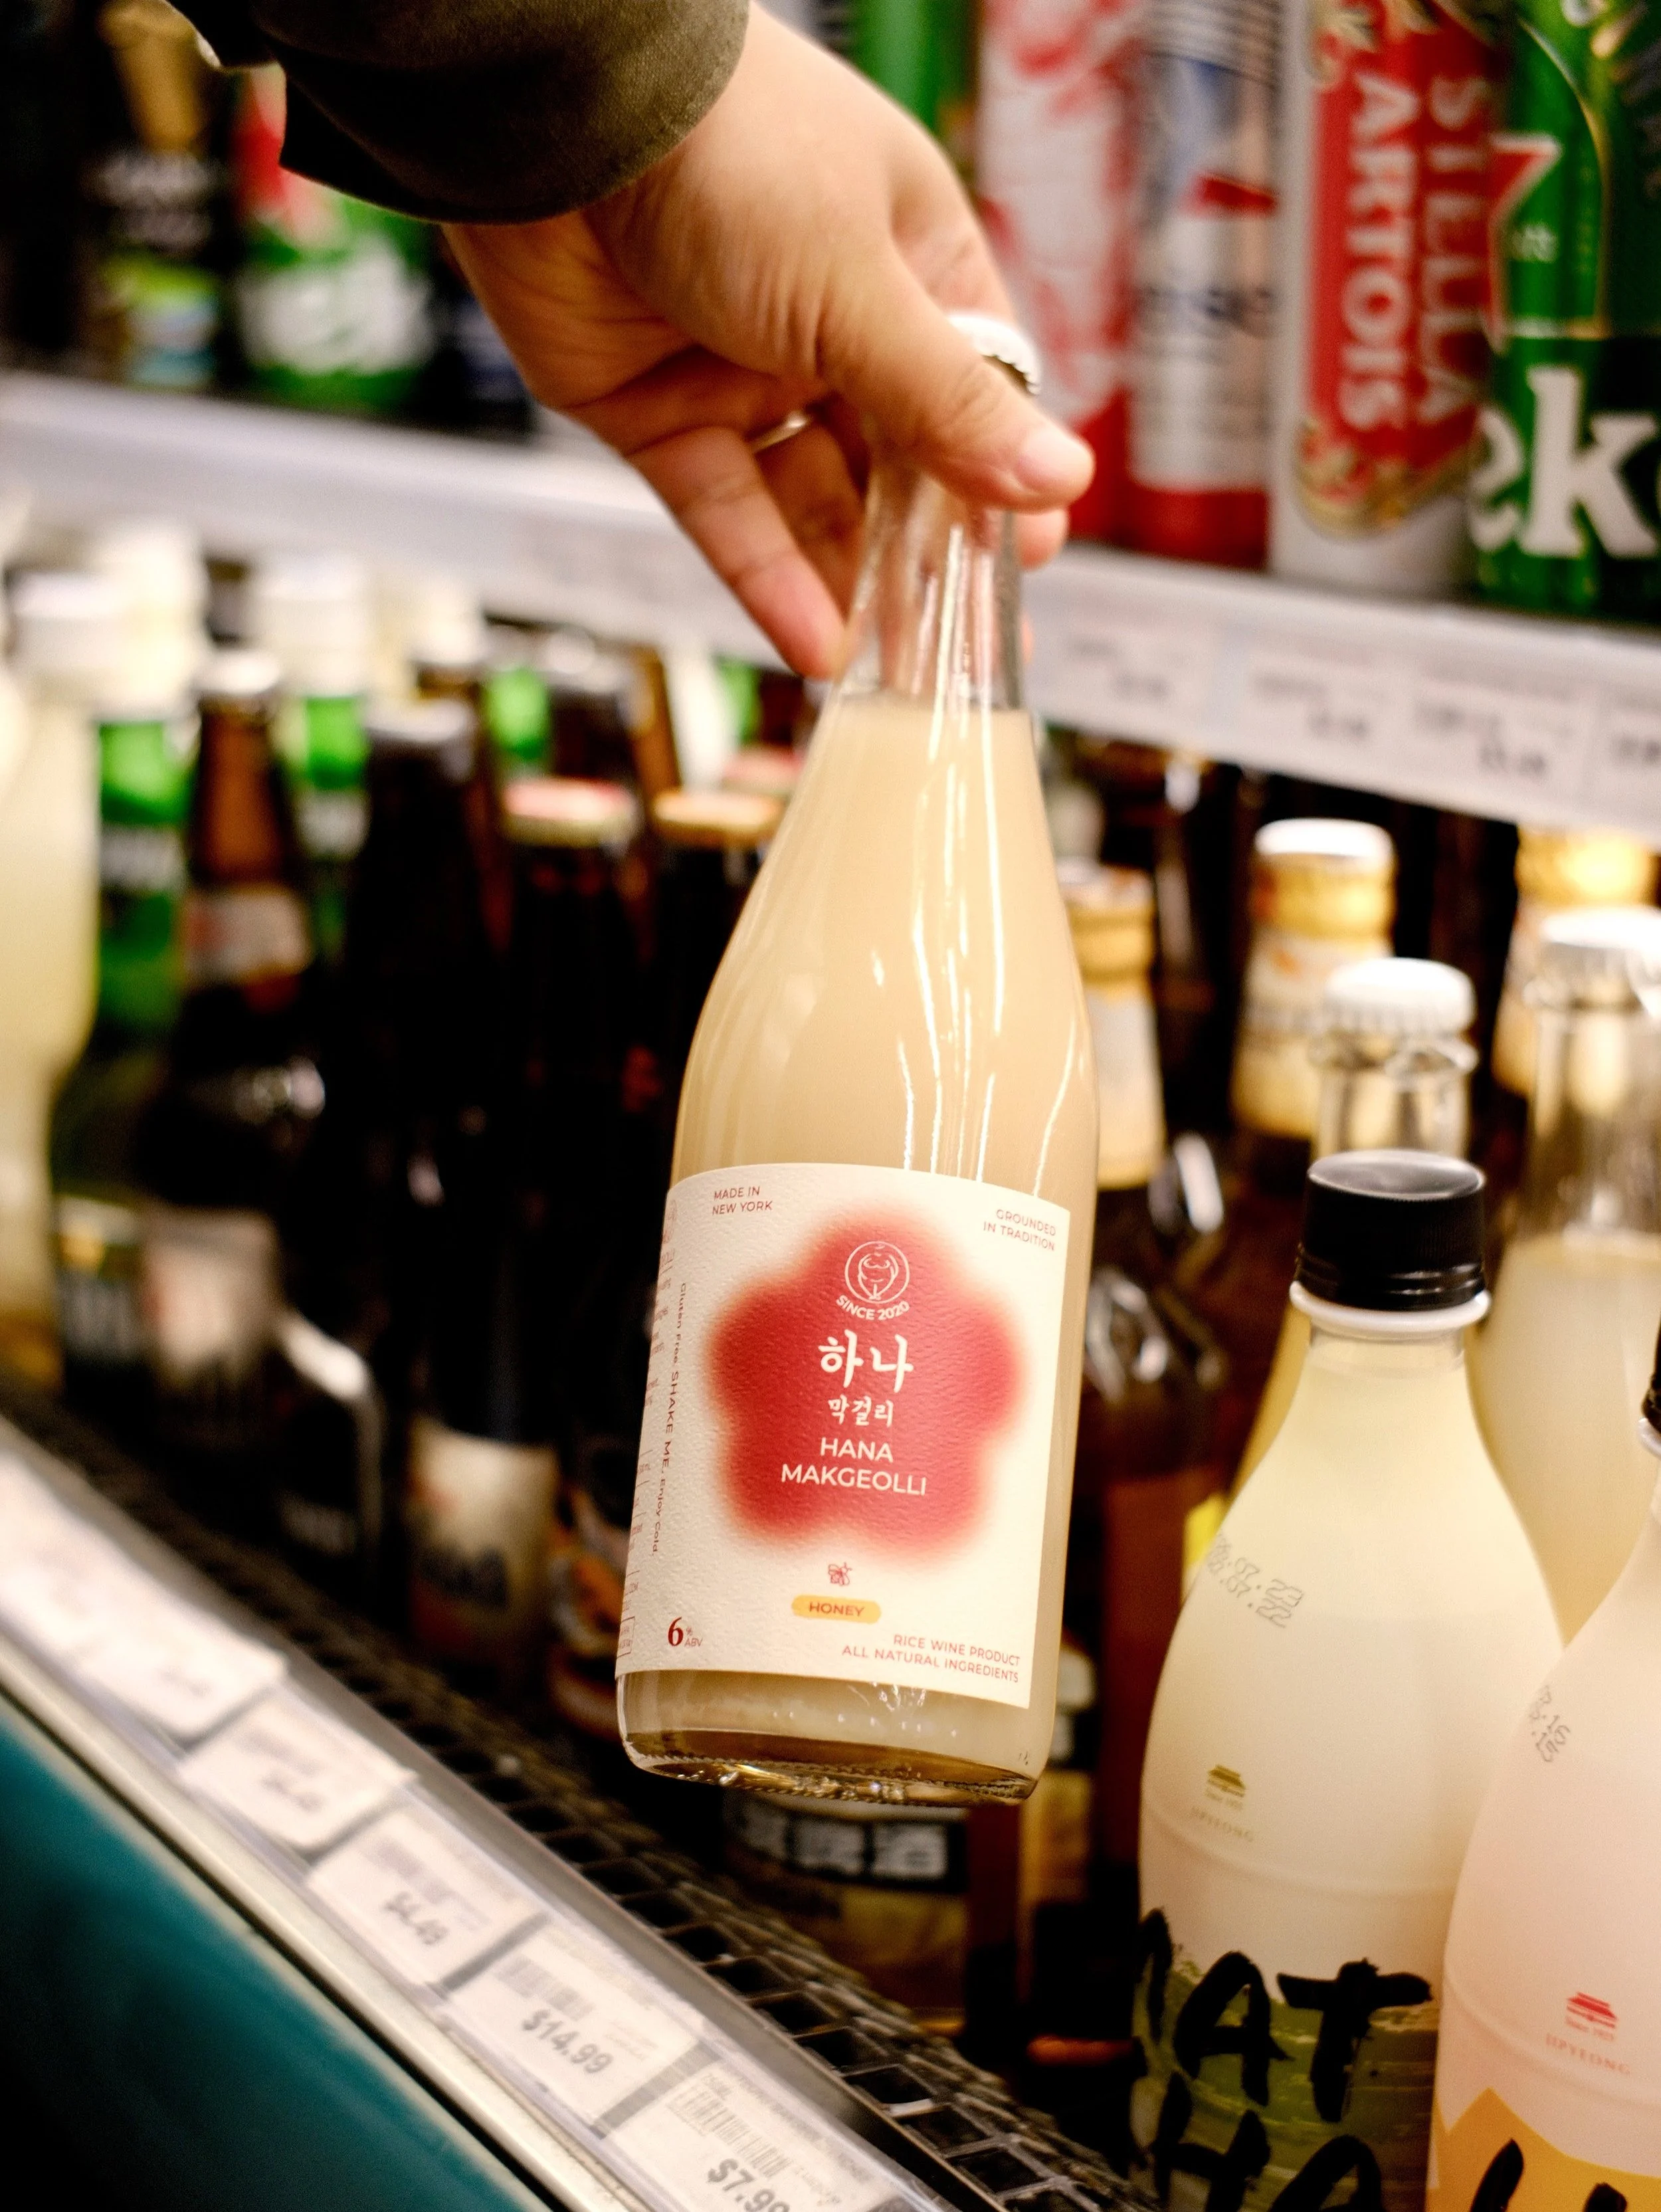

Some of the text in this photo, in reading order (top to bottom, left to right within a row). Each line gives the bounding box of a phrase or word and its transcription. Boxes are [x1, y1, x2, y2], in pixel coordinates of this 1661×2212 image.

[1339, 73, 1420, 431] ARTOIS
[712, 1200, 773, 1216] NEW YORK
[713, 1185, 761, 1201] MADE IN
[983, 1221, 1056, 1252] IN TRADITION
[996, 1209, 1056, 1237] GROUNDED
[676, 1282, 686, 1330] Gluten
[836, 1294, 910, 1320] SINCE 2020
[818, 1329, 914, 1393] 하나
[666, 1371, 679, 1434] SHAKE
[828, 1394, 894, 1428] 막걸리
[661, 1441, 672, 1474] ME.
[820, 1437, 894, 1463] HANA
[781, 1463, 927, 1496] MAKGEOLLI
[655, 1478, 666, 1517] Enjoy
[651, 1521, 661, 1556] Cold.
[809, 1601, 864, 1617] HONEY
[684, 1637, 703, 1647] ABV
[893, 1634, 1021, 1667] RICE WINE PRODUCT
[842, 1645, 1019, 1683] ALL NATURAL INGREDIENTS
[522, 2009, 614, 2074] $14.99
